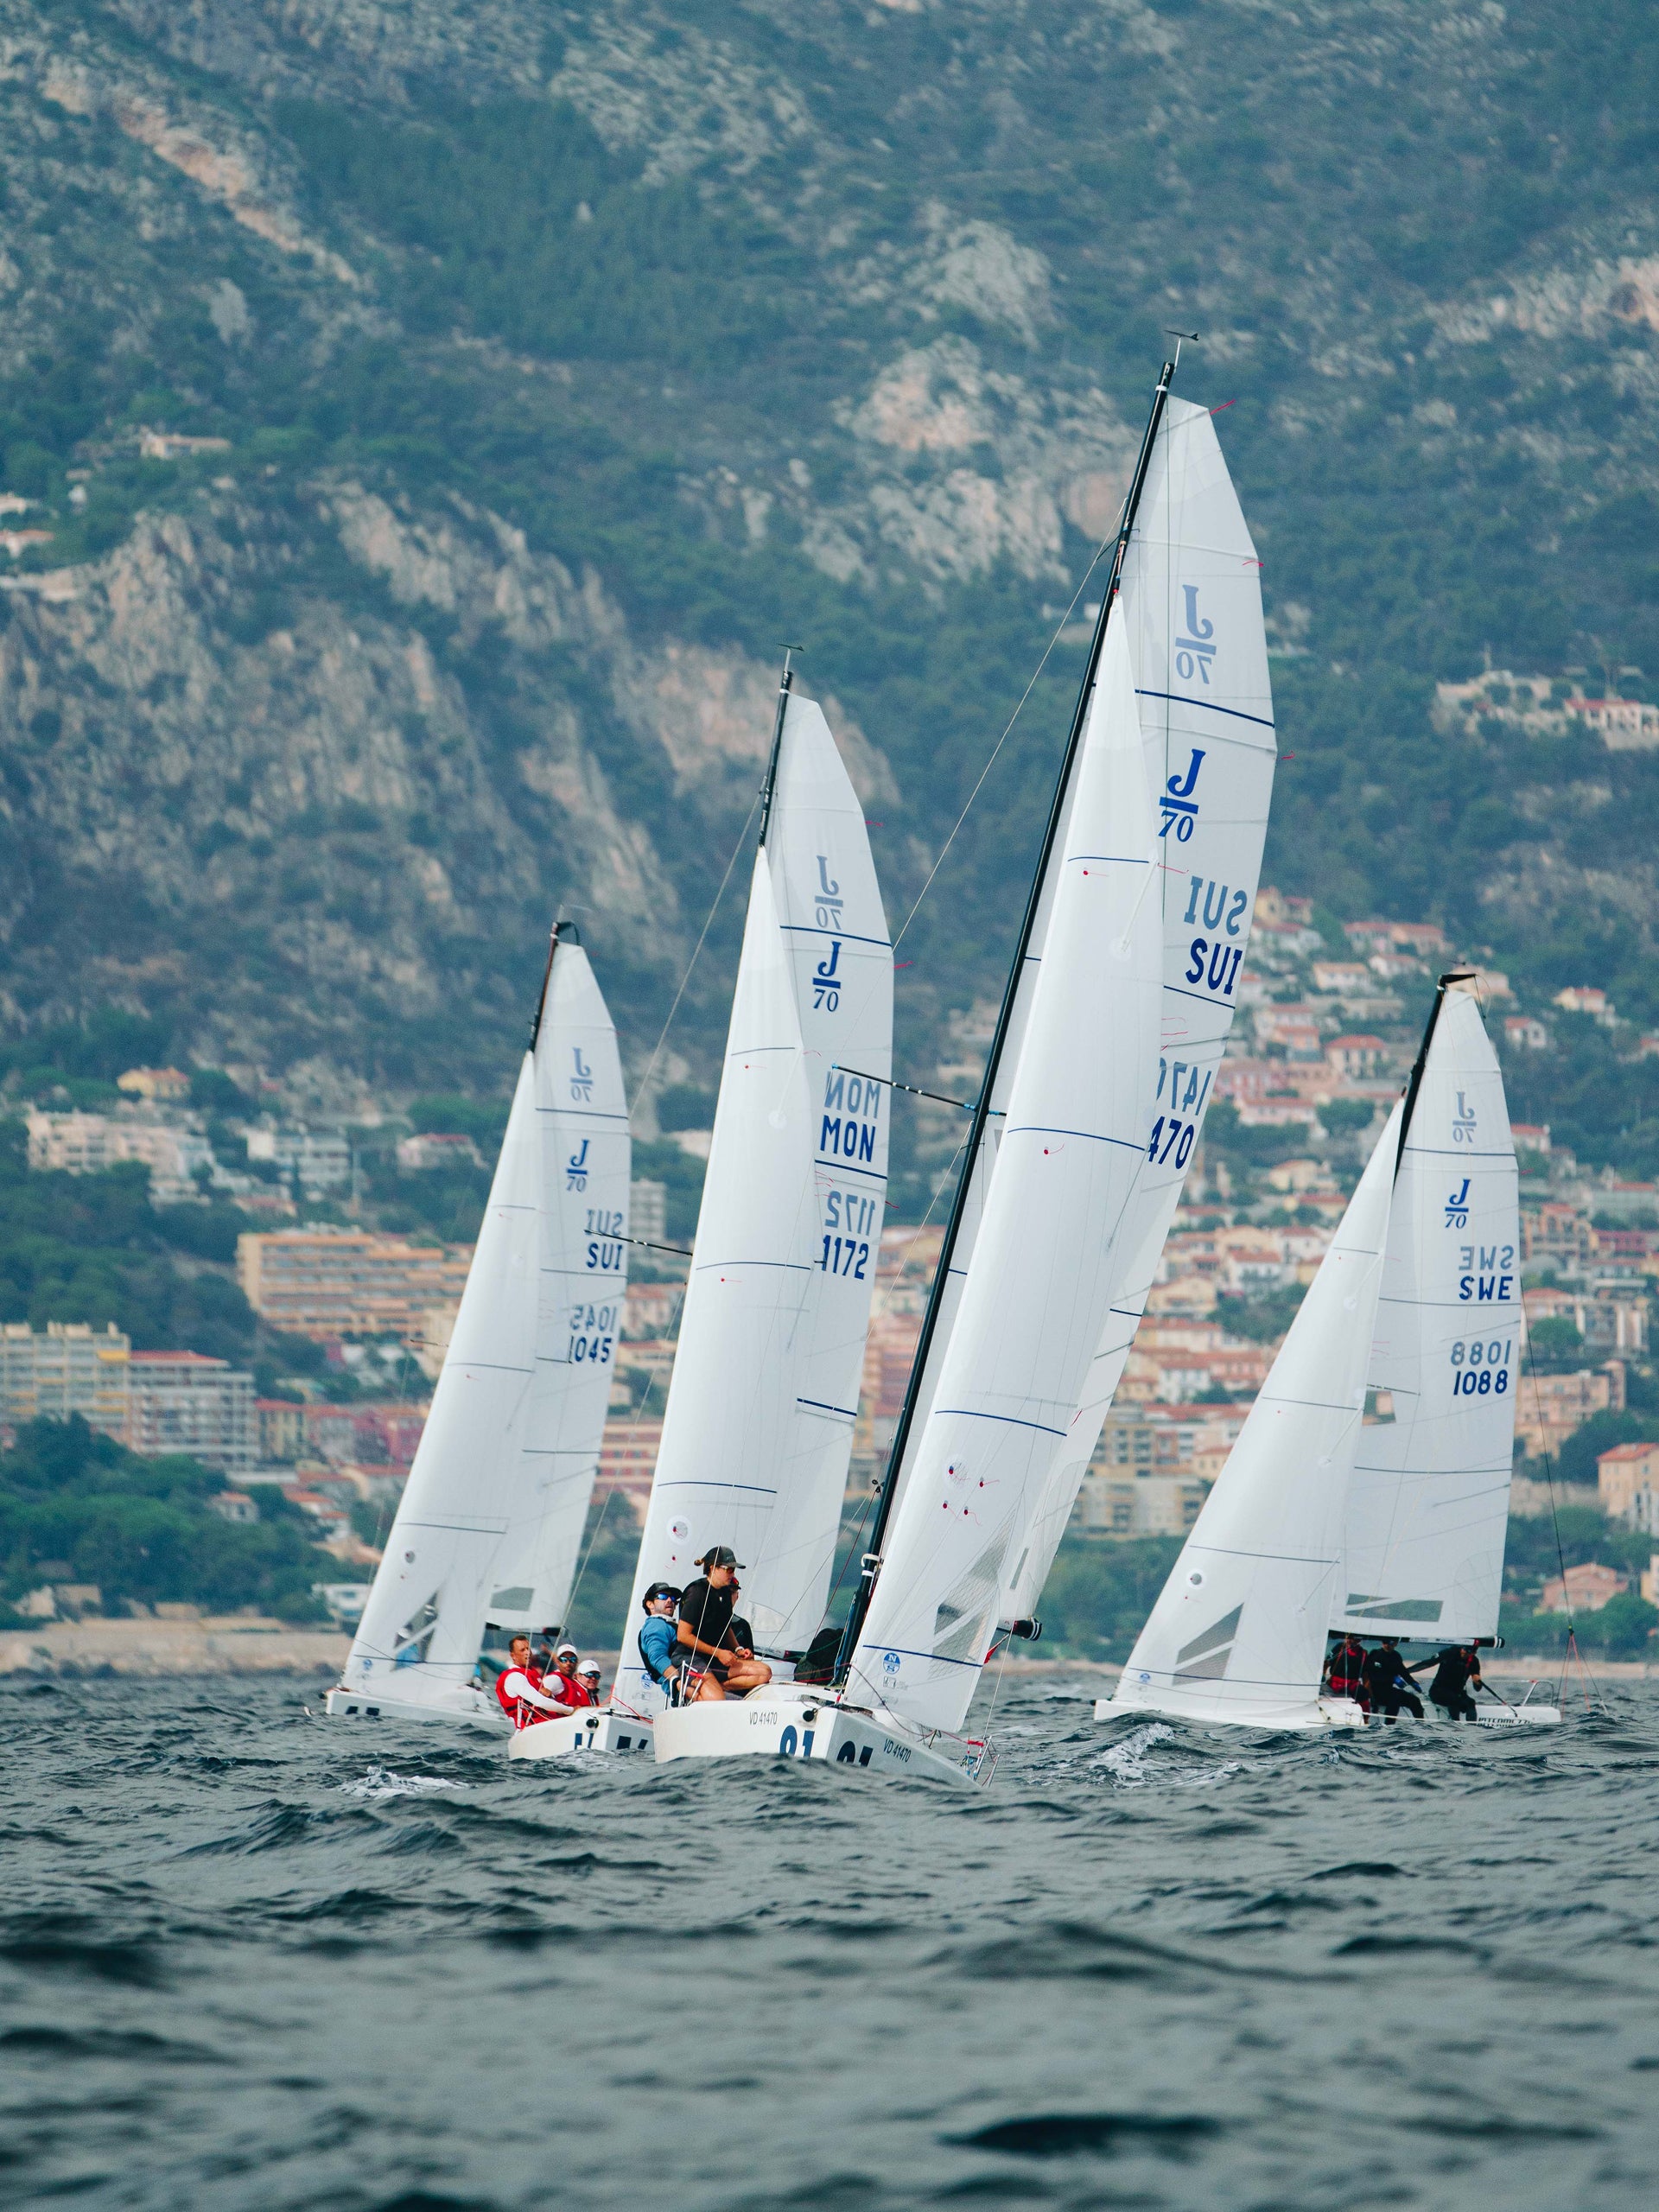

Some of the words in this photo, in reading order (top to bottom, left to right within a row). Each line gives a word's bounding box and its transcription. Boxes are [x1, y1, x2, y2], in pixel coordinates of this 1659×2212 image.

[1167, 748, 1206, 798] J
[1158, 810, 1194, 842] 70
[817, 941, 842, 977] J
[1185, 938, 1243, 995] SUI
[813, 988, 839, 1012] 70
[820, 1115, 876, 1162] MON
[570, 1139, 590, 1167] J
[566, 1176, 588, 1192] 70
[1449, 1179, 1471, 1205] J
[1445, 1213, 1467, 1229] 70
[586, 1243, 623, 1270] SUI
[822, 1234, 869, 1280] 1172
[1459, 1275, 1513, 1300] SWE
[569, 1335, 612, 1363] 1045
[1453, 1370, 1509, 1395] 1088
[749, 1712, 758, 1725] VD
[759, 1712, 778, 1725] 41470
[883, 1738, 894, 1754] VD
[893, 1744, 912, 1763] 41470
